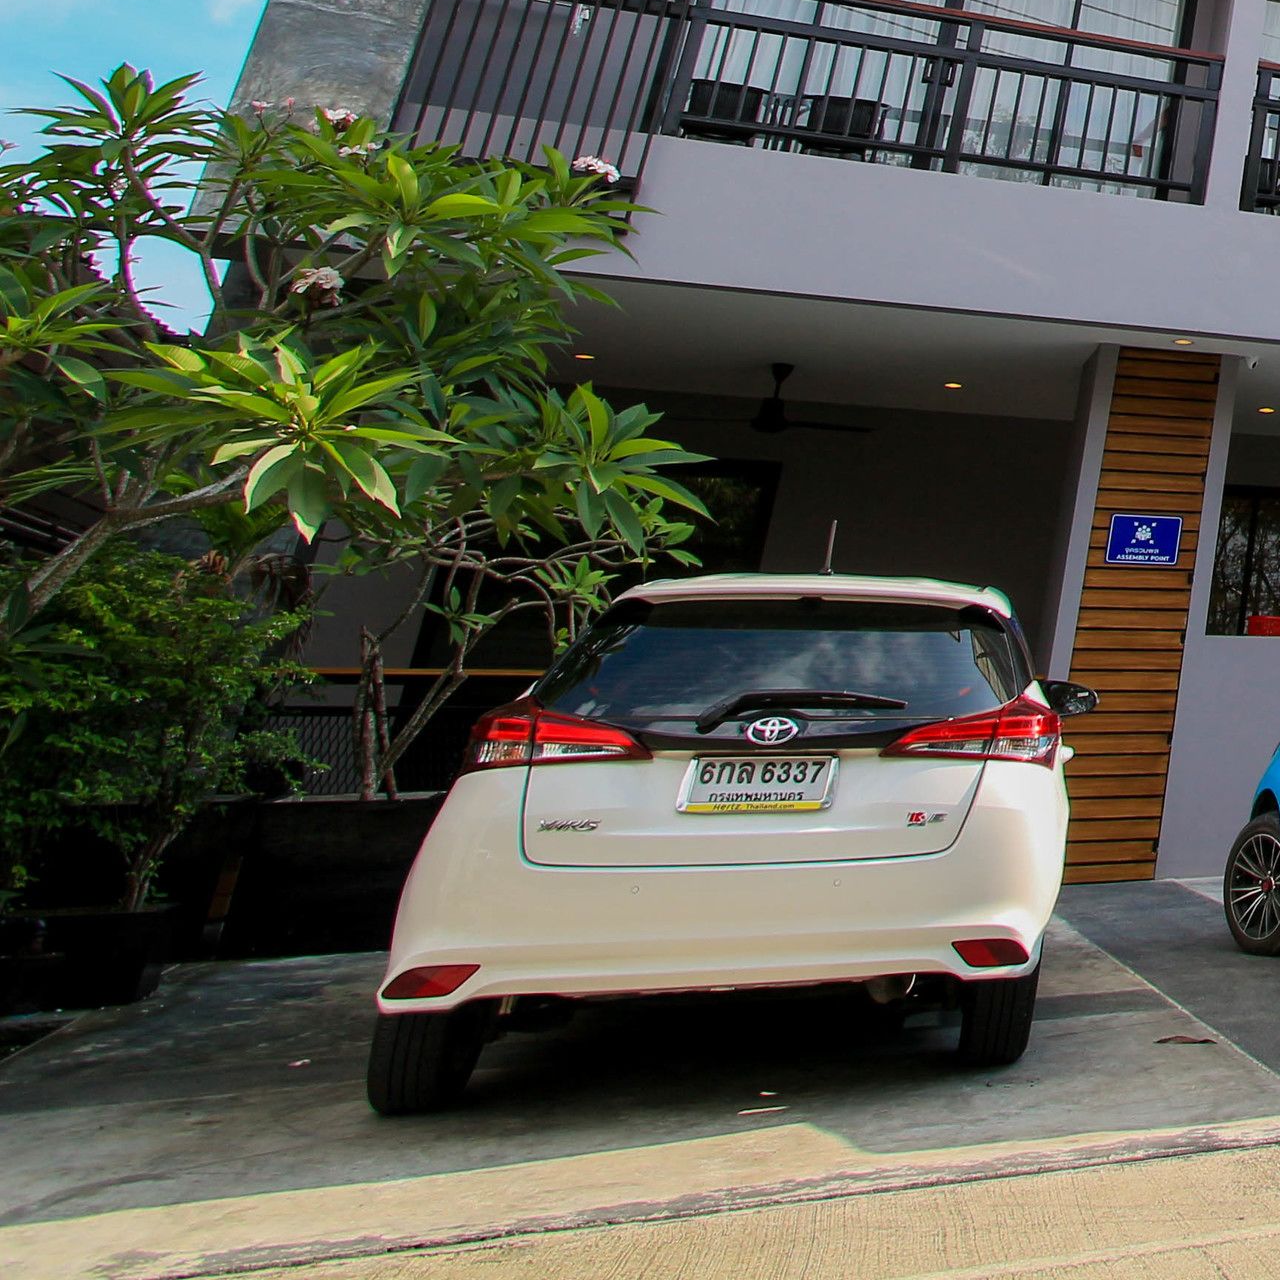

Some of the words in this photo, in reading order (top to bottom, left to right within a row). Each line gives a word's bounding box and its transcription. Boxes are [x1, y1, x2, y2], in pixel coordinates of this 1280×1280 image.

[700, 761, 756, 784] 6กล
[760, 761, 826, 784] 6337
[709, 791, 804, 802] กรงเทพมหานคร
